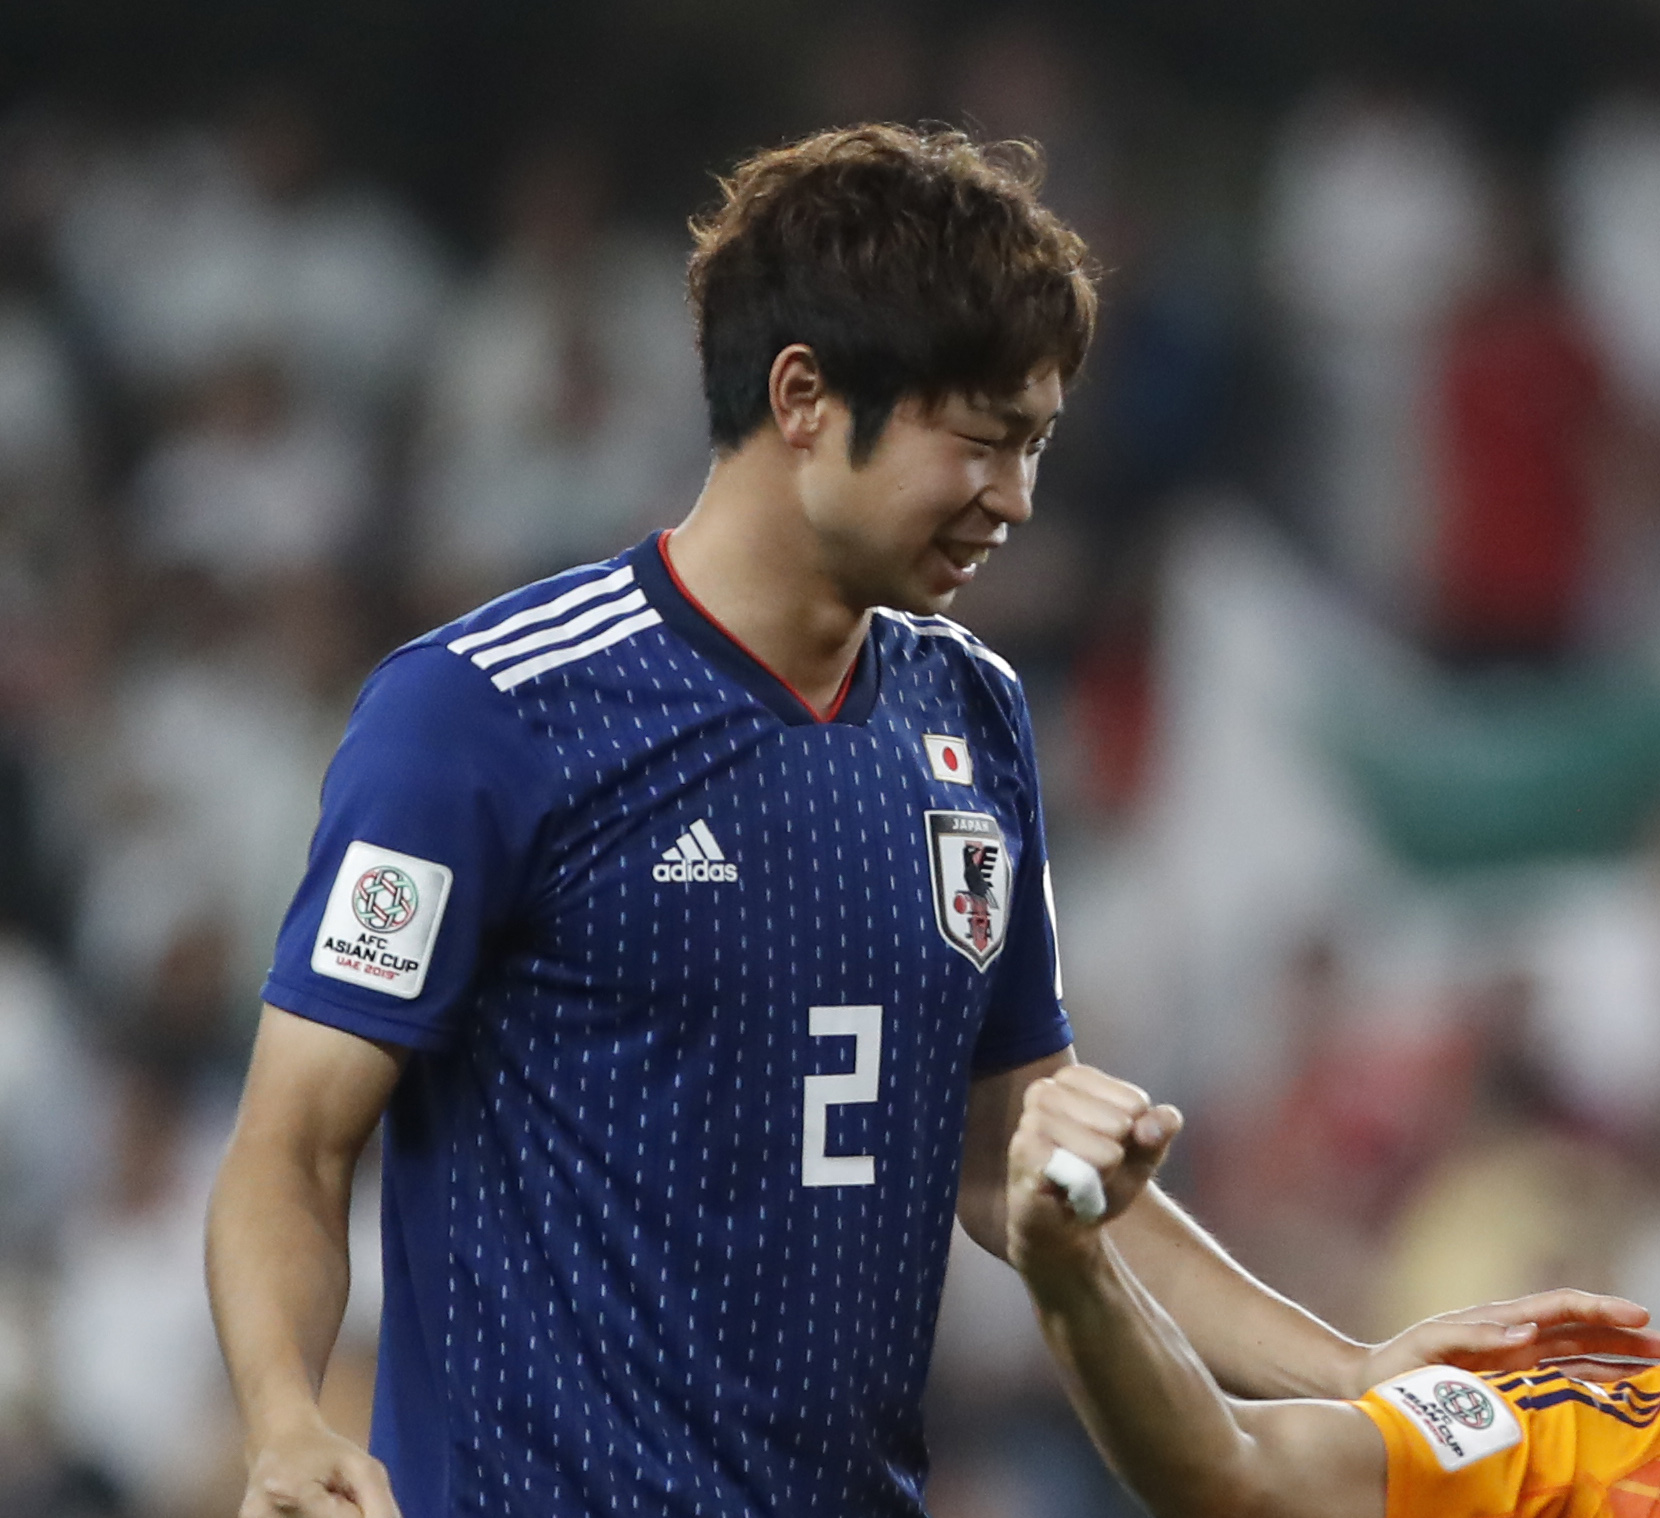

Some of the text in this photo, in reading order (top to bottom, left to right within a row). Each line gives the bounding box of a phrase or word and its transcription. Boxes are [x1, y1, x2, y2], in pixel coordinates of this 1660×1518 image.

[952, 818, 990, 832] JAPAN
[652, 860, 738, 882] adidas
[357, 933, 388, 949] AFC
[323, 937, 419, 973] ASIAN CUP
[336, 956, 362, 970] UAE
[801, 1005, 882, 1187] 2
